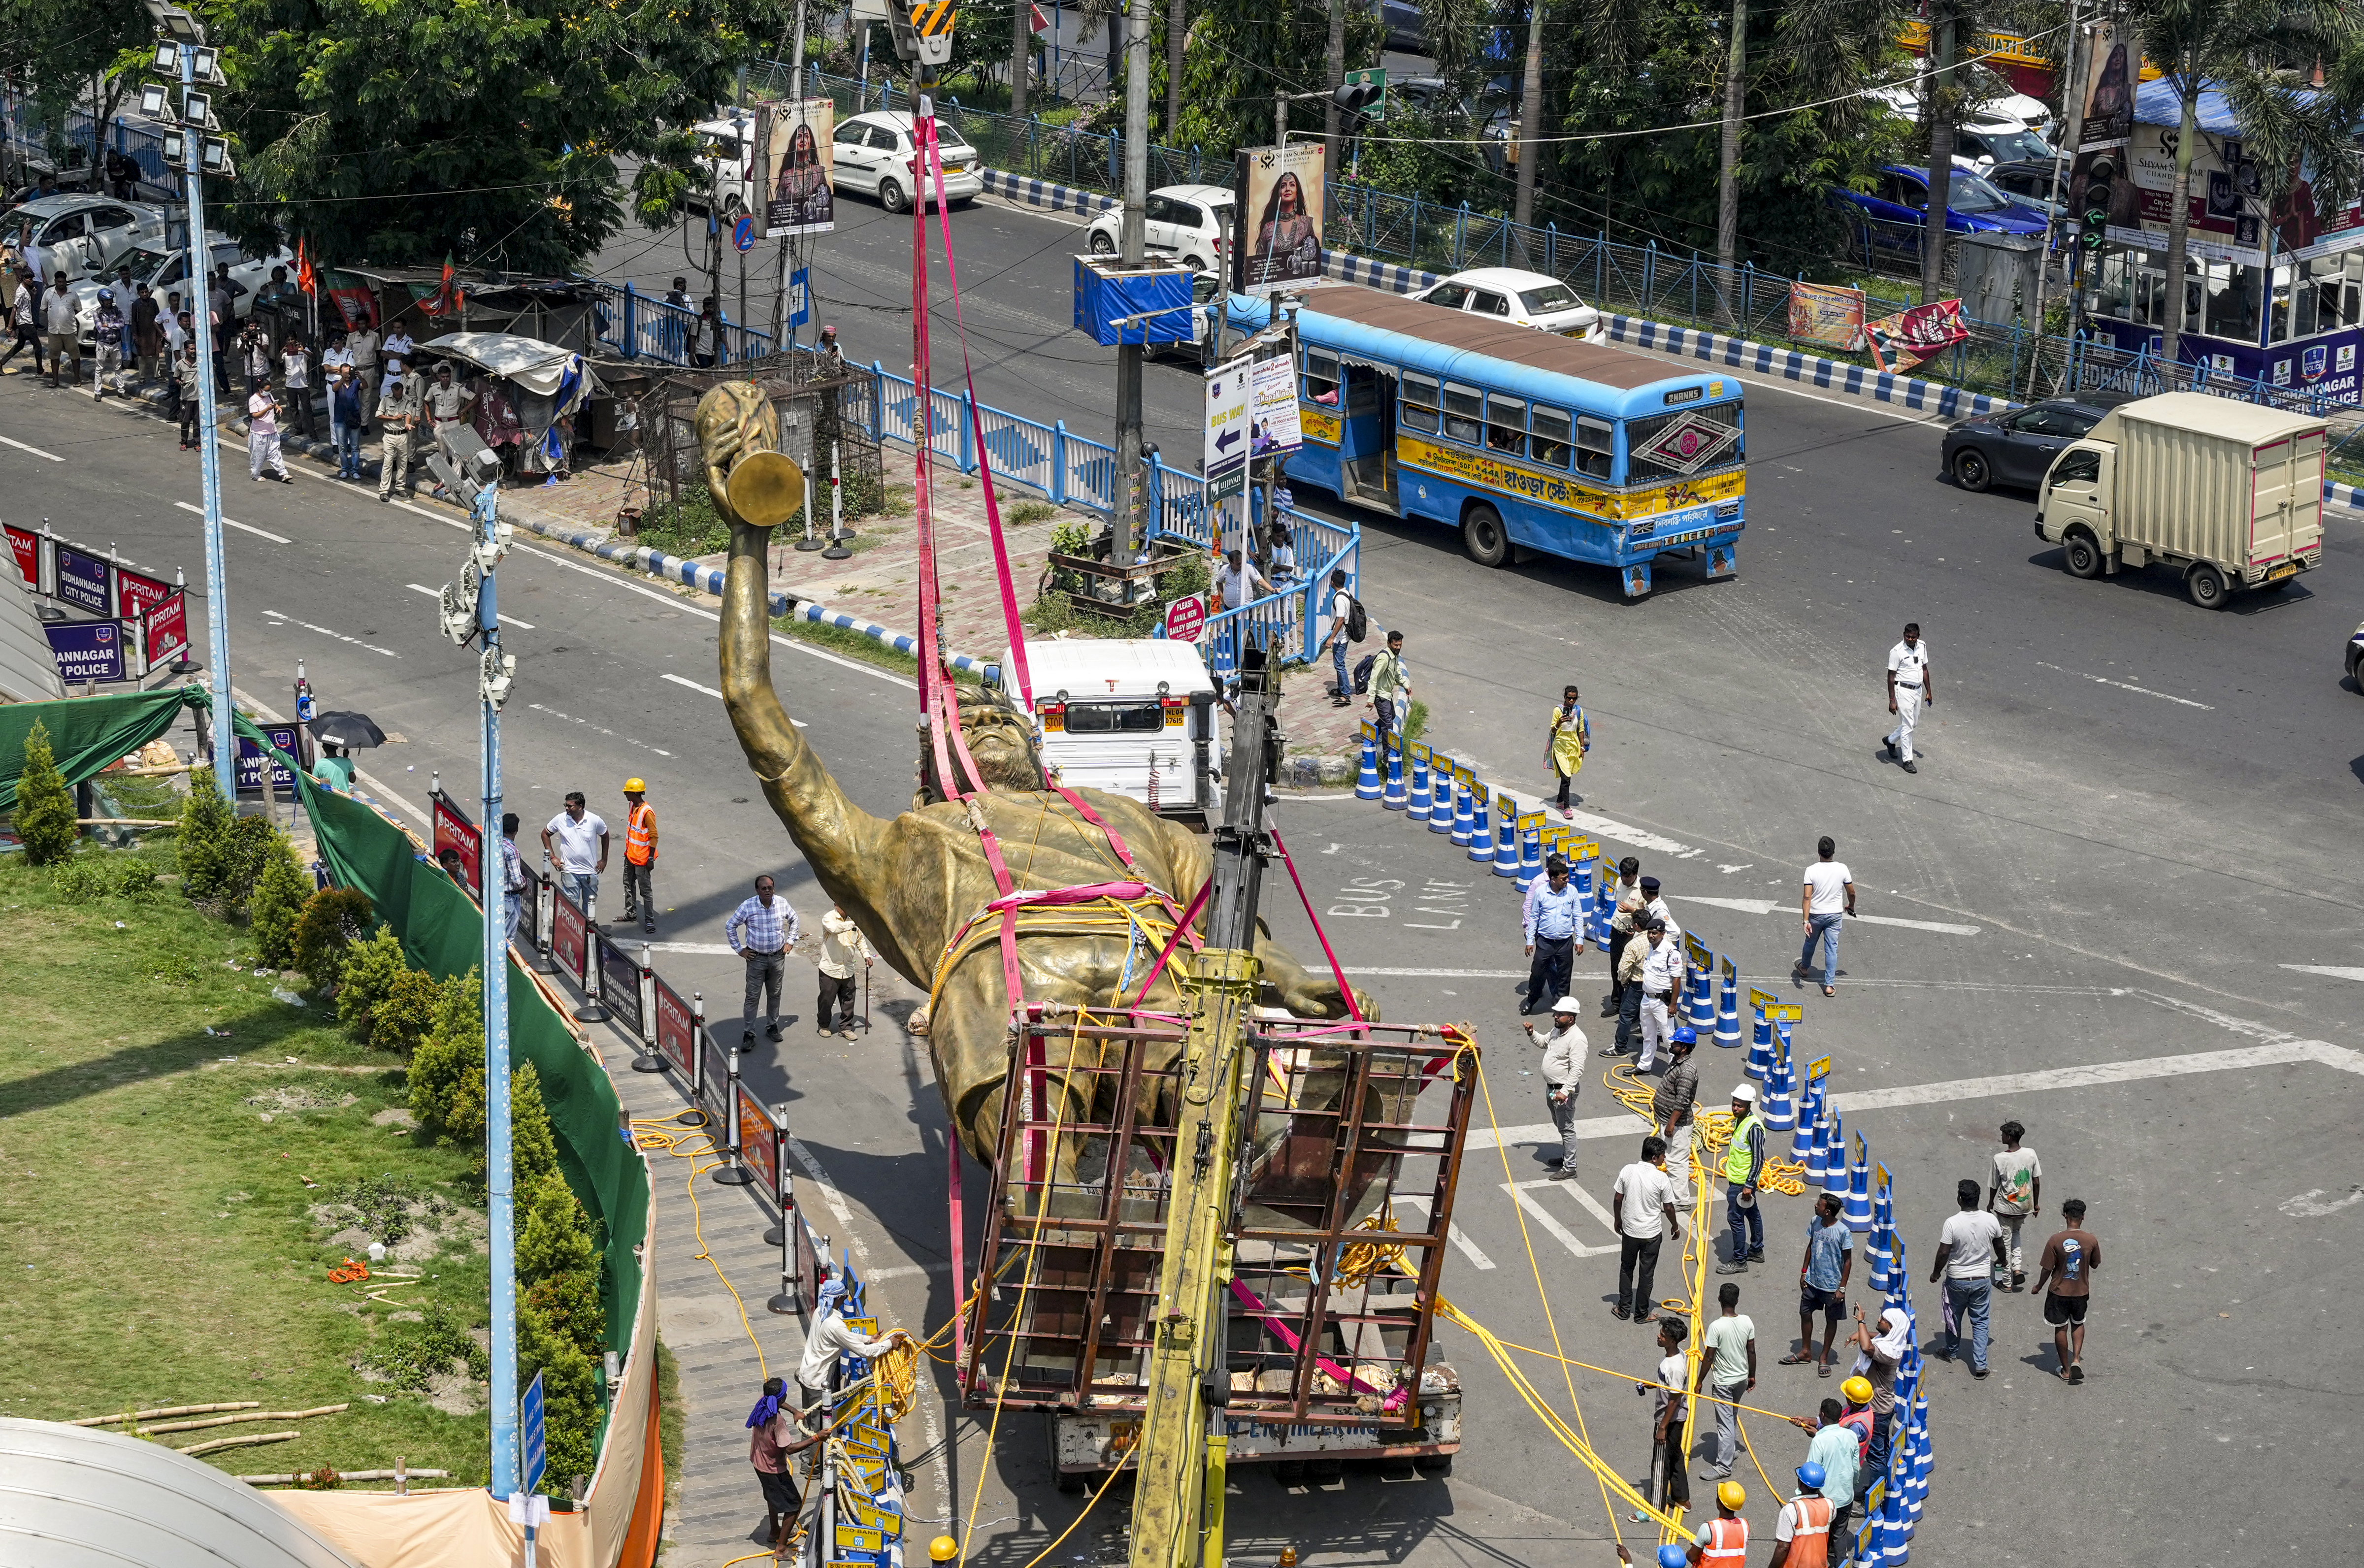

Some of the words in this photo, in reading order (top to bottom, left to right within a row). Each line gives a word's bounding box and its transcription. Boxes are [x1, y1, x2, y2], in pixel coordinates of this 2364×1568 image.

[2139, 158, 2167, 172] SHYAM
[1271, 362, 1275, 372] 2
[2305, 363, 2323, 372] POLICE
[1211, 411, 1227, 428] BUS
[1229, 403, 1245, 421] WAY
[1481, 467, 1499, 479] 44A
[1504, 470, 1545, 498] হাওড়া
[1664, 528, 1714, 547] DANGER
[1717, 525, 1731, 534] SAVE
[1731, 522, 1743, 531] LIFE
[1634, 542, 1648, 552] SAFE
[1648, 540, 1662, 549] DRIVE
[62, 570, 105, 596] BIDHANNAGAR
[65, 585, 79, 598] CITY
[80, 590, 102, 608] POLICE
[1177, 599, 1194, 612] PLEASE
[154, 601, 181, 626] PRITAM
[1174, 613, 1187, 623] AVAIL
[1187, 609, 1197, 619] NEW
[1169, 624, 1186, 636] BAILEY
[1186, 618, 1202, 630] BRIDGE
[66, 663, 109, 676] POLICE
[1045, 717, 1063, 730] STOP
[321, 733, 345, 745] KOUZINA
[444, 816, 475, 852] PRITAM
[1327, 877, 1406, 917] BUS
[561, 906, 584, 939] PRITAM
[603, 970, 637, 1008] BIDHANNAGAR
[607, 988, 618, 1005] CITY
[618, 997, 636, 1022] POLICE
[664, 998, 689, 1033] PRITAM
[704, 1067, 726, 1112] BIDHANNAGAR
[704, 1088, 713, 1107] CITY
[746, 1107, 772, 1146] PRITAM
[878, 1510, 897, 1520] BANK
